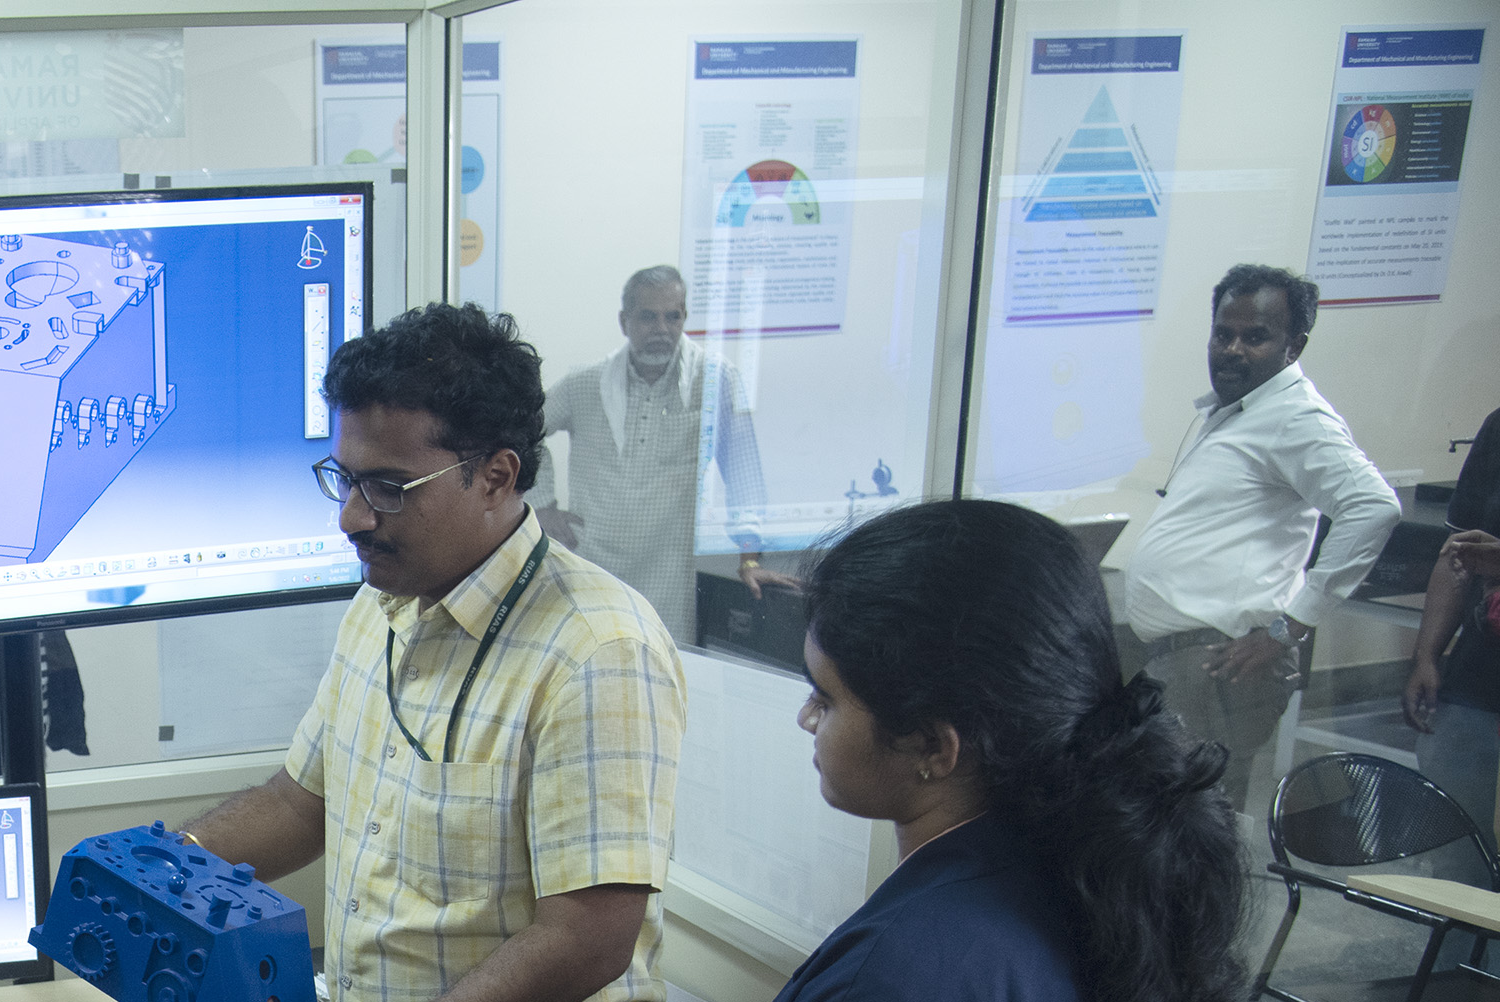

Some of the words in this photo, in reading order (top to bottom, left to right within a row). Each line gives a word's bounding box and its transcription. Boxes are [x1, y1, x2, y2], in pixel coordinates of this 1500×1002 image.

[1362, 137, 1373, 152] SI
[518, 560, 536, 586] RUAS
[489, 604, 508, 634] RUAS
